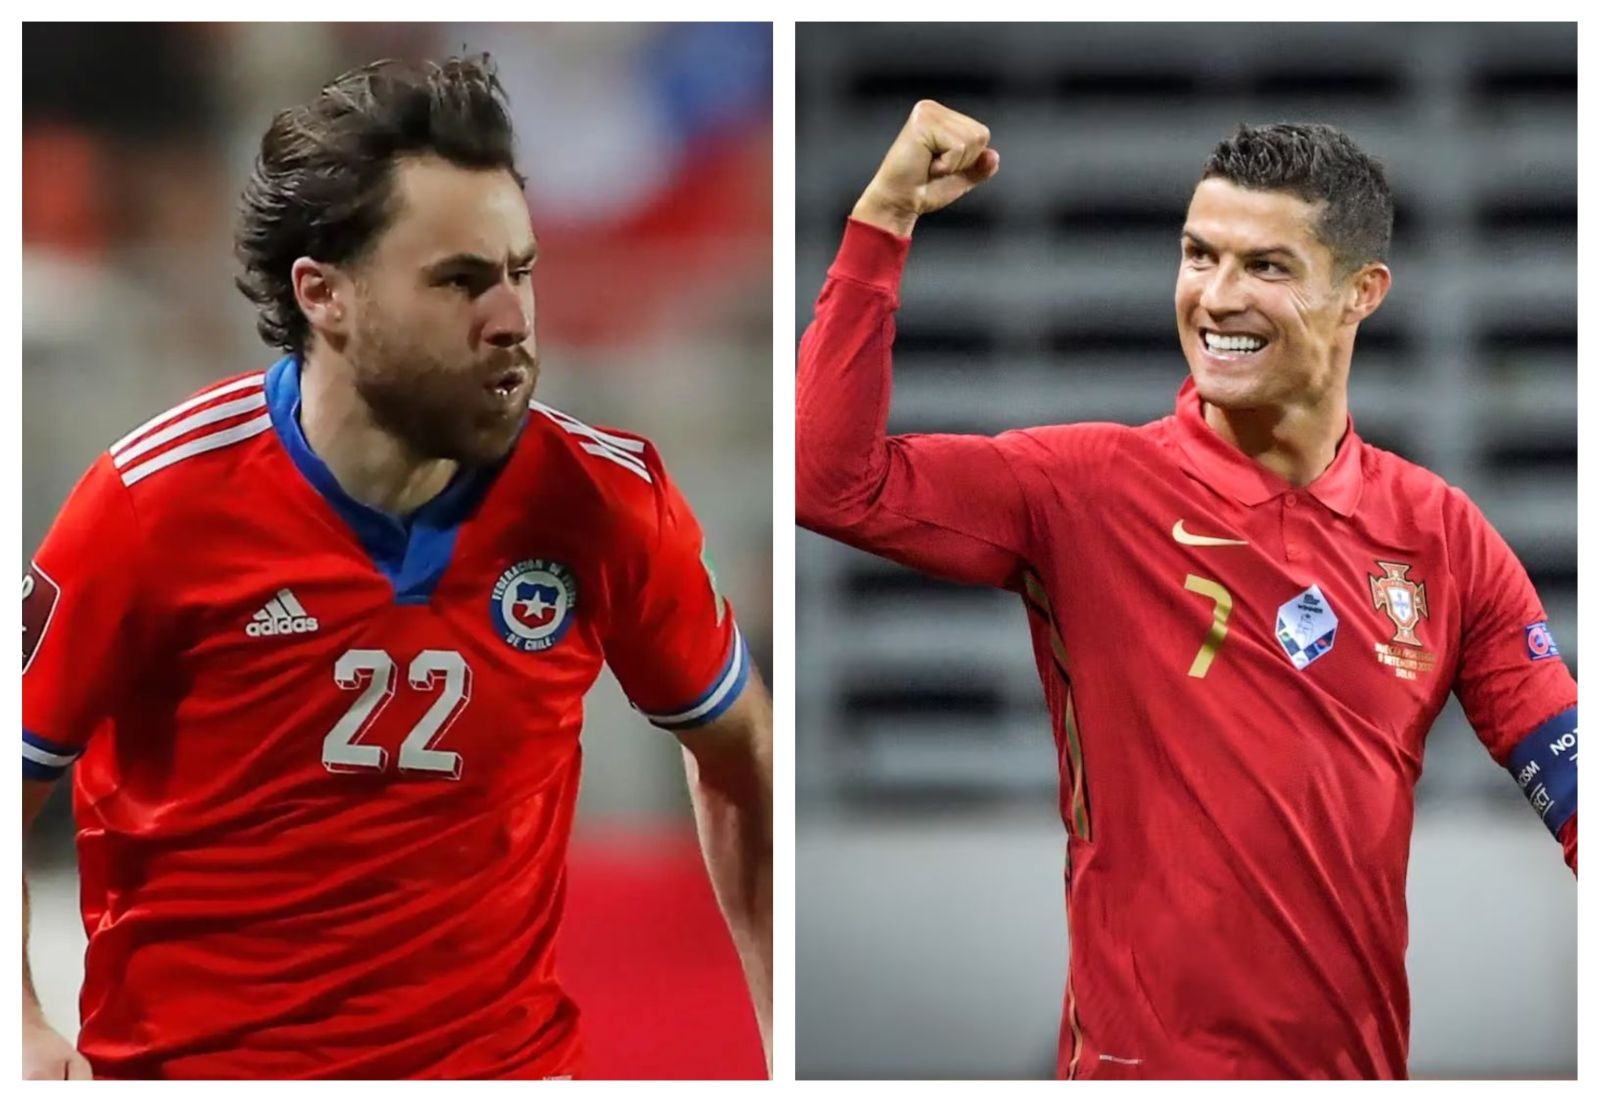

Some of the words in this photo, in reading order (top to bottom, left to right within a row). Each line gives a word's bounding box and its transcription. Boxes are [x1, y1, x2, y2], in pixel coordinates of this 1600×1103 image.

[246, 616, 319, 637] adidas
[506, 633, 521, 648] DE
[524, 637, 553, 651] CHILE
[1184, 574, 1233, 679] 7
[322, 649, 473, 781] 22
